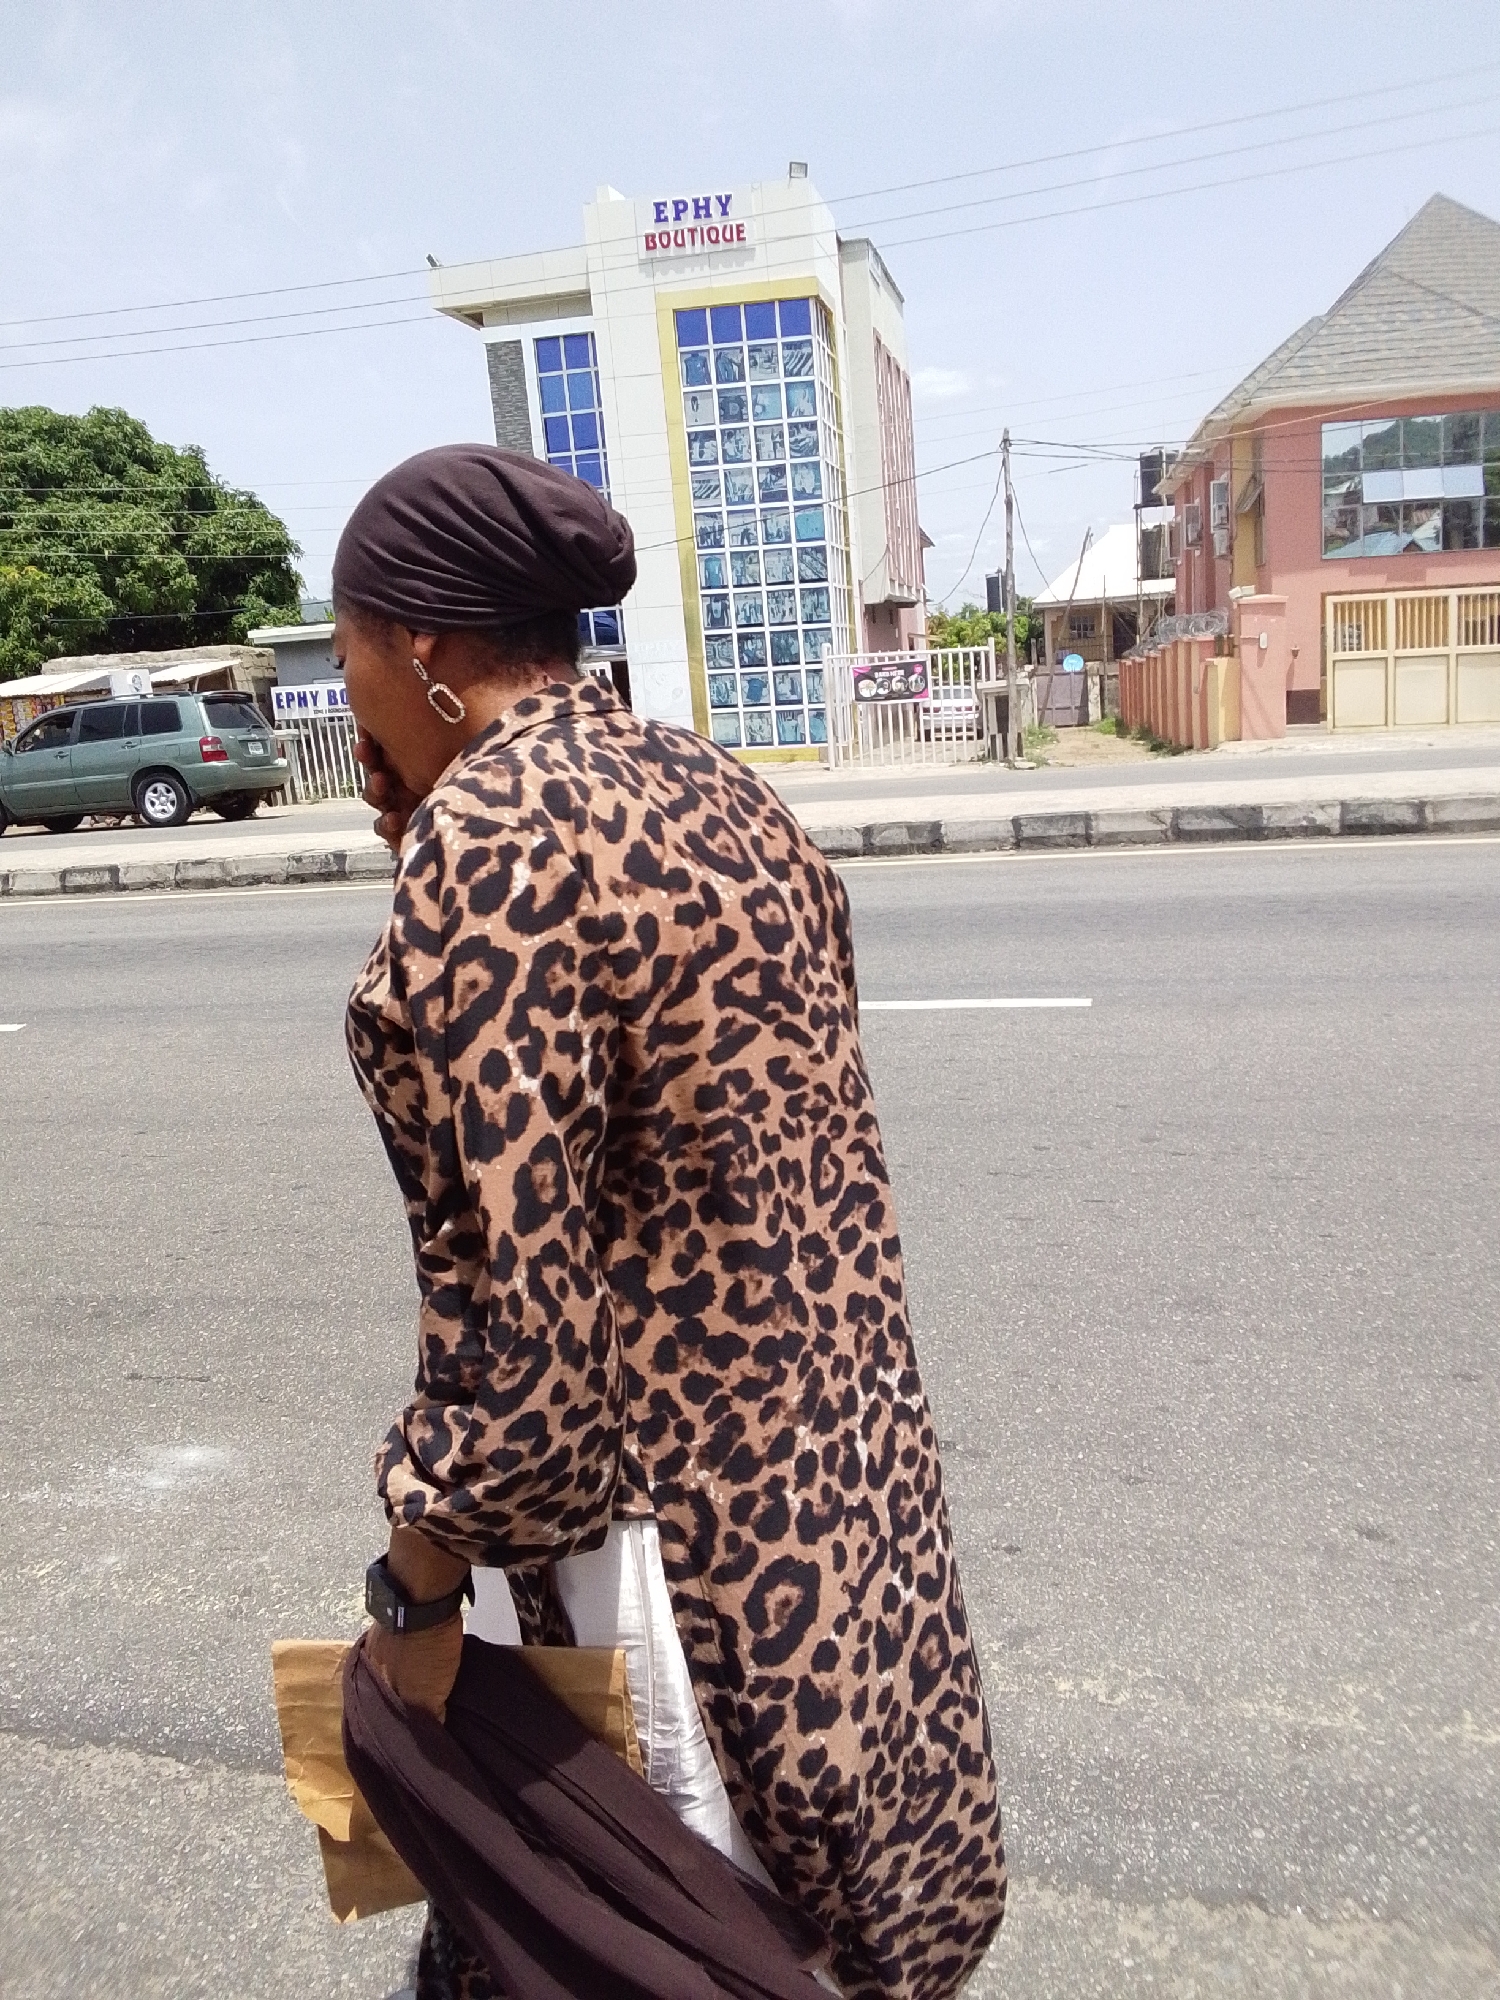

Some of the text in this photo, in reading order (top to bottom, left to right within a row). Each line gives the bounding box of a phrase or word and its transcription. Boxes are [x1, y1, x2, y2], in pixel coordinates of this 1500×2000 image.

[653, 194, 733, 223] EPHY
[645, 223, 747, 251] BOUTIQUE
[275, 690, 319, 709] EPHY
